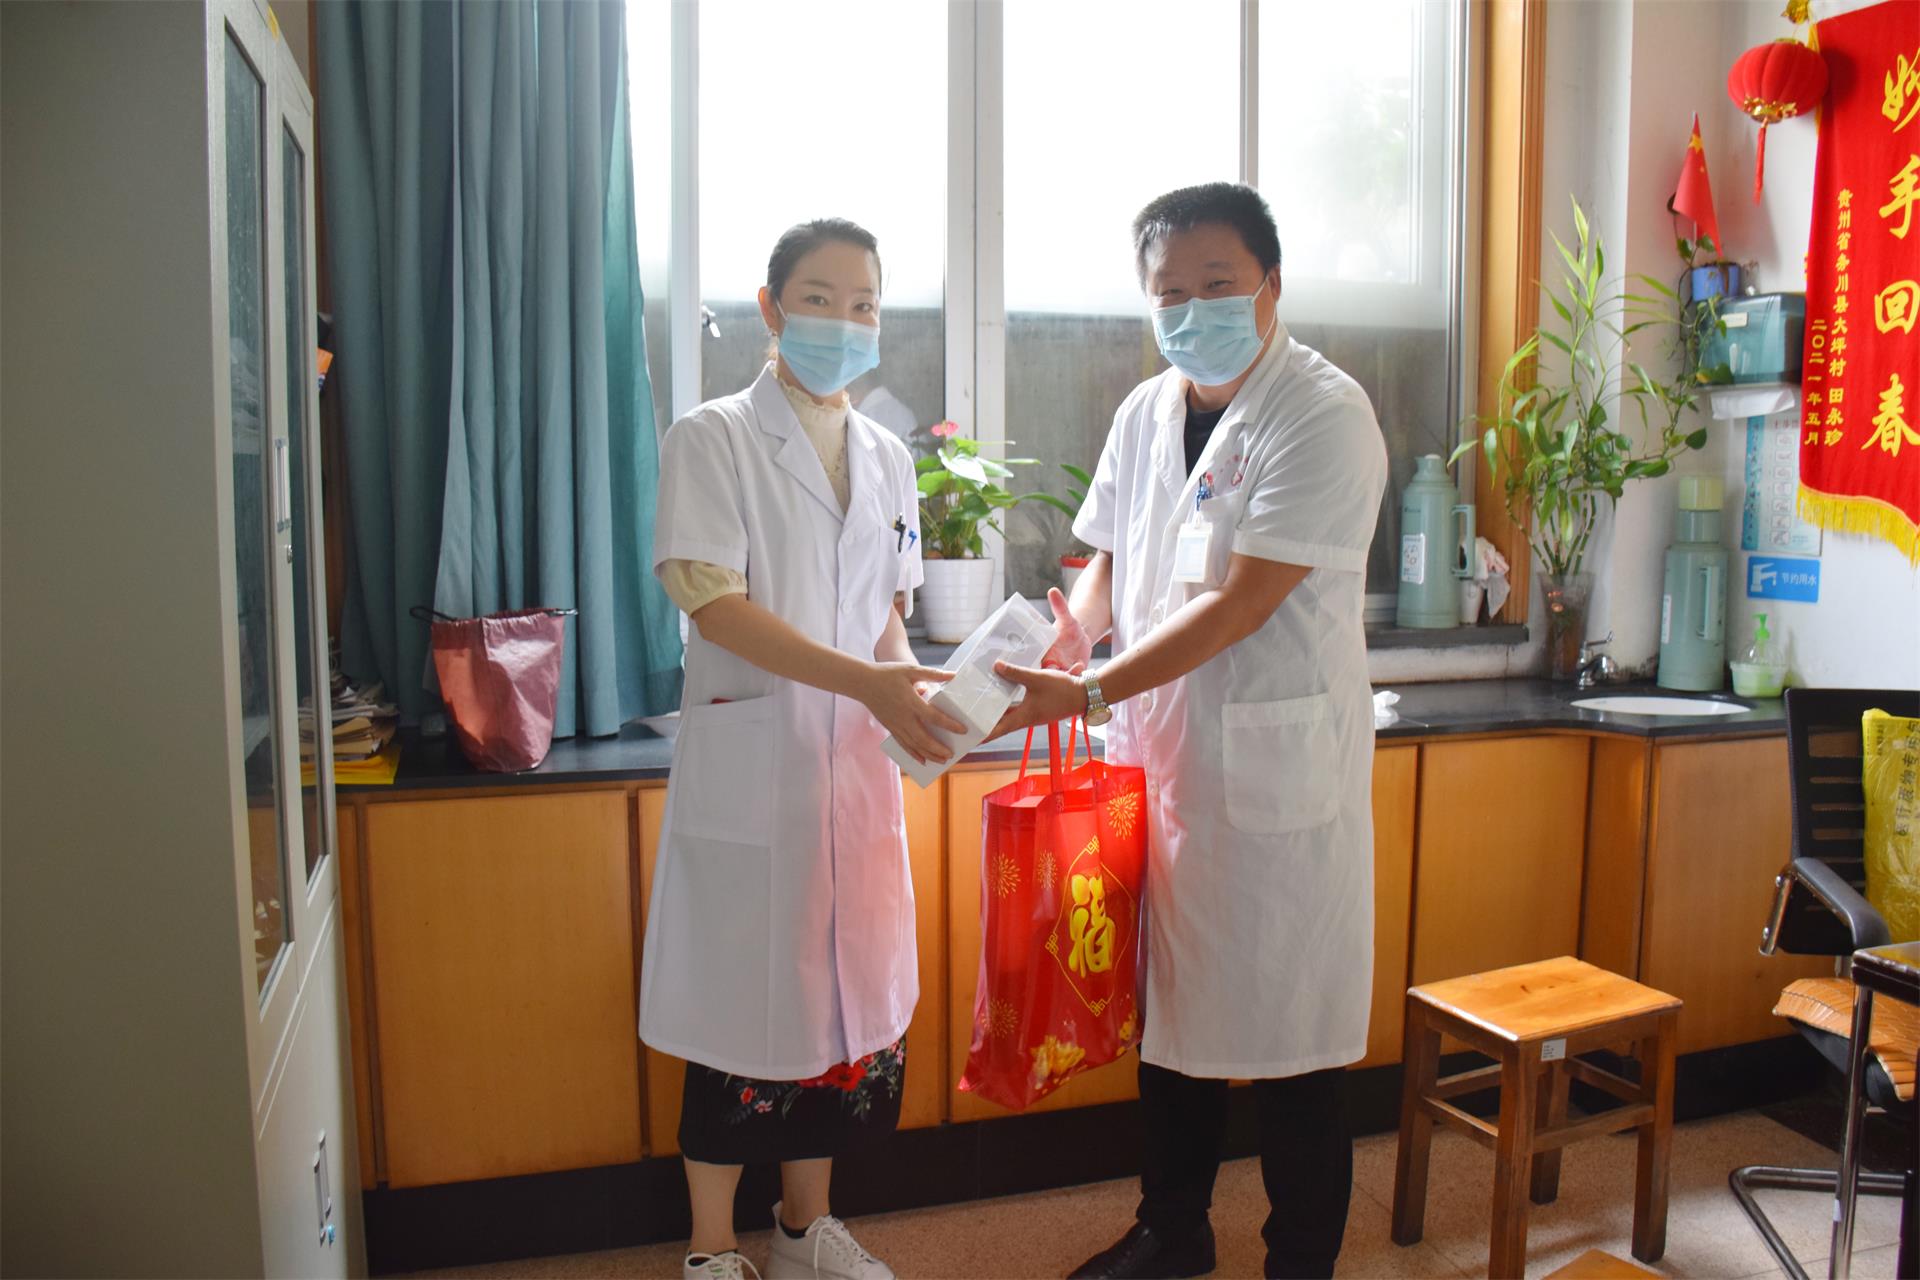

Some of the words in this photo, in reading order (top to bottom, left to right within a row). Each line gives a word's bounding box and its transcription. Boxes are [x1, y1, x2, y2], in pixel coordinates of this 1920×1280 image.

[1861, 47, 1920, 457] 妙手回春
[1782, 572, 1817, 587] 节约用水
